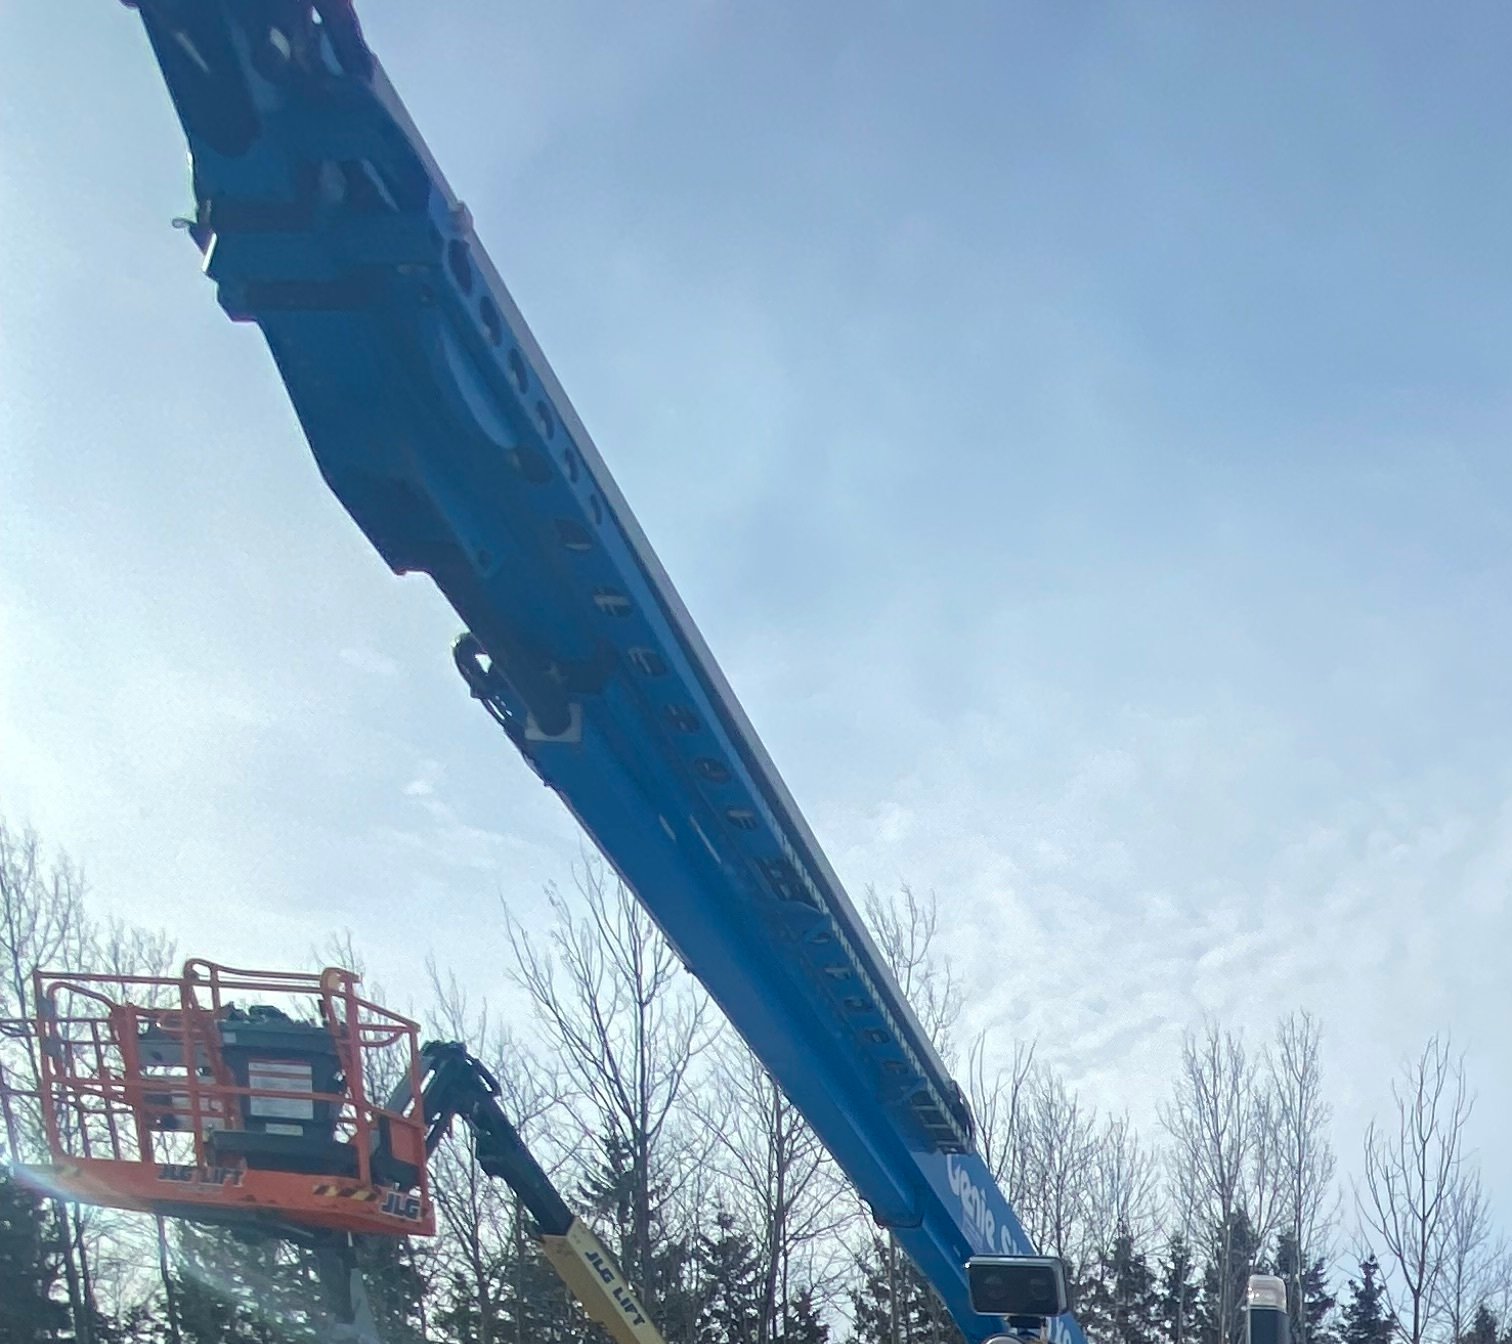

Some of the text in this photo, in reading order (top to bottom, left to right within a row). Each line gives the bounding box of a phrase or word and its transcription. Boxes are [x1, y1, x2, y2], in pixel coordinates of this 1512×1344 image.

[380, 1191, 422, 1222] JLG
[585, 1252, 645, 1325] JLG LIFT
